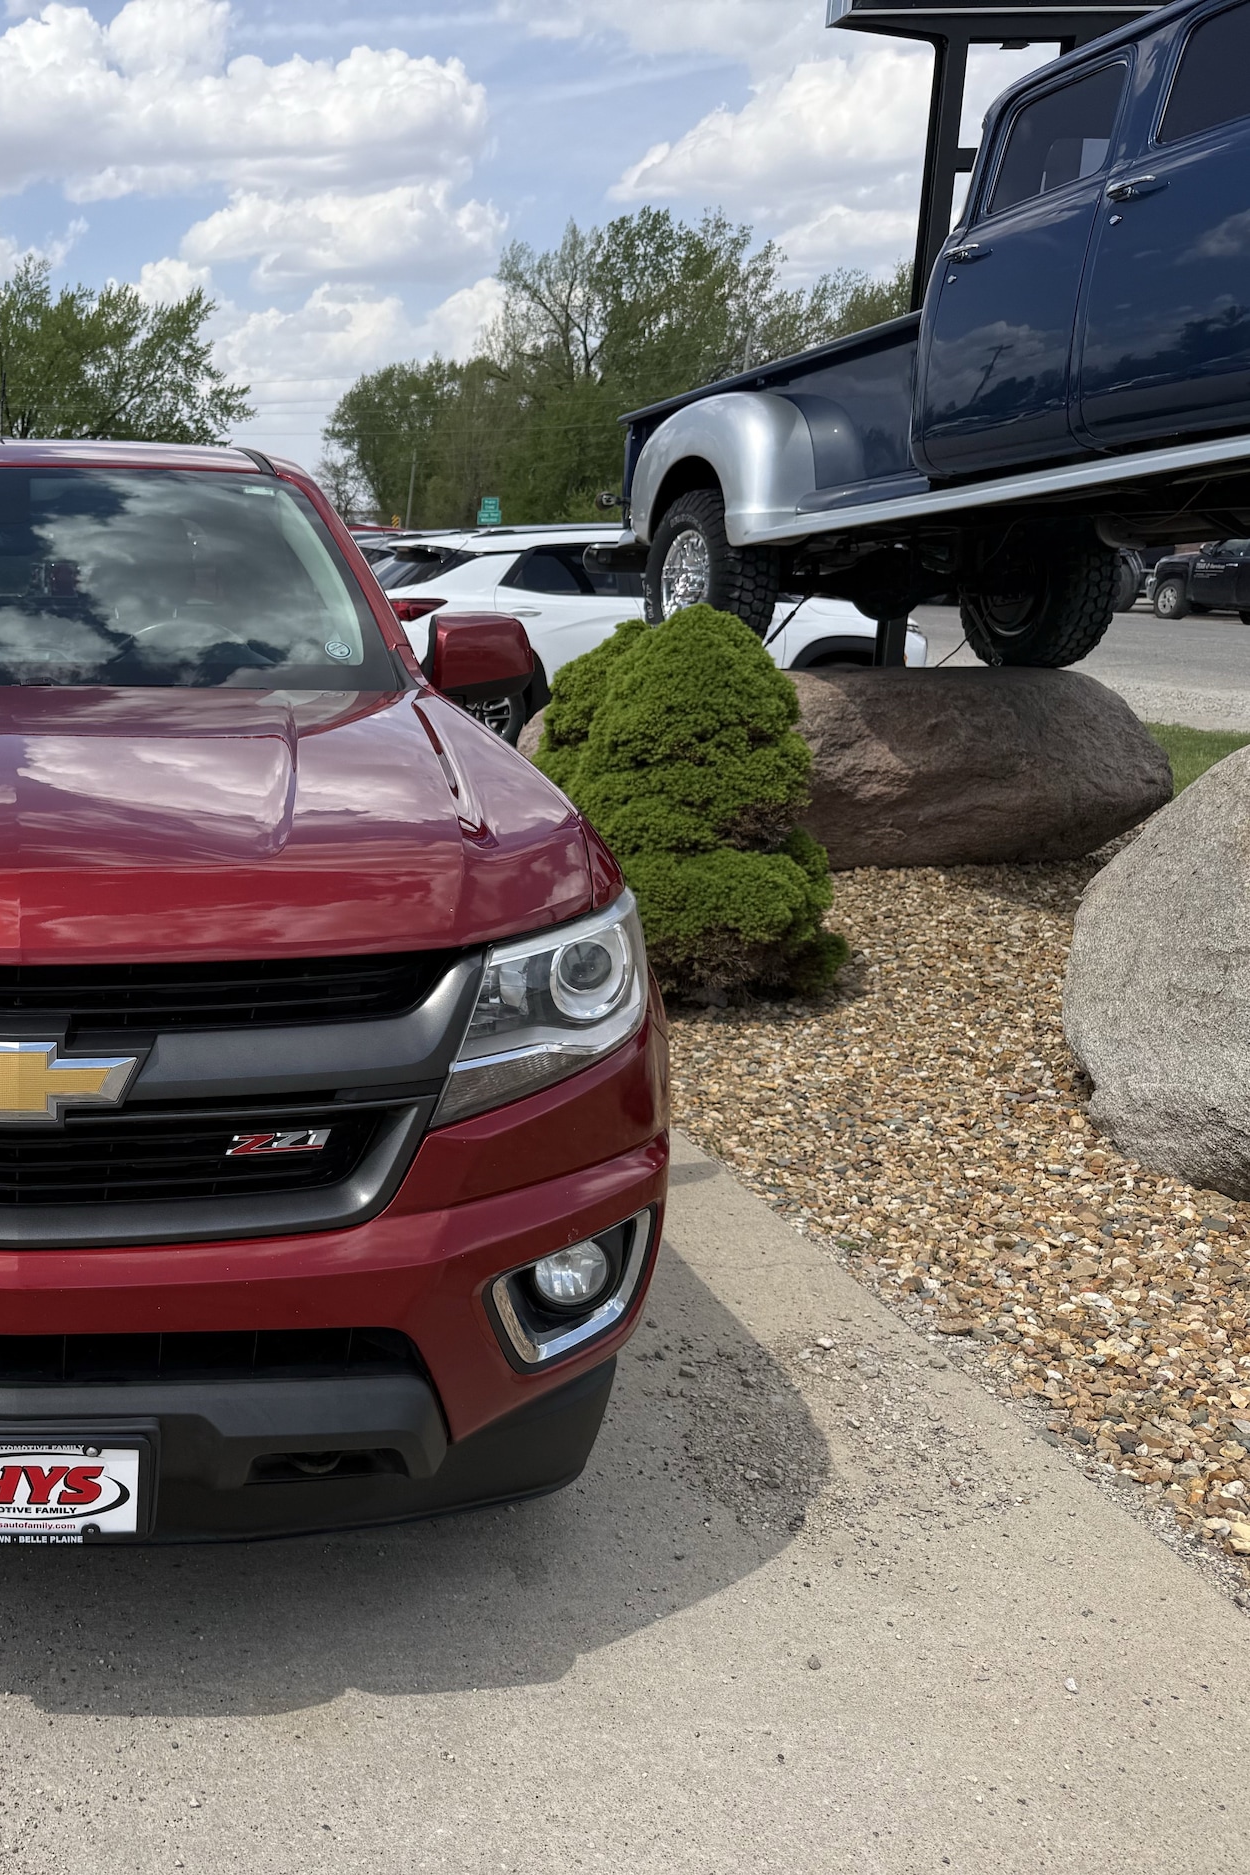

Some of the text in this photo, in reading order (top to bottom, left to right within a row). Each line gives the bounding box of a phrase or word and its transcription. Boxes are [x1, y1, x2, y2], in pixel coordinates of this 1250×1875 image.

[225, 1129, 332, 1156] Z71
[18, 1535, 48, 1544] BELLE
[50, 1535, 84, 1544] PLAINE
